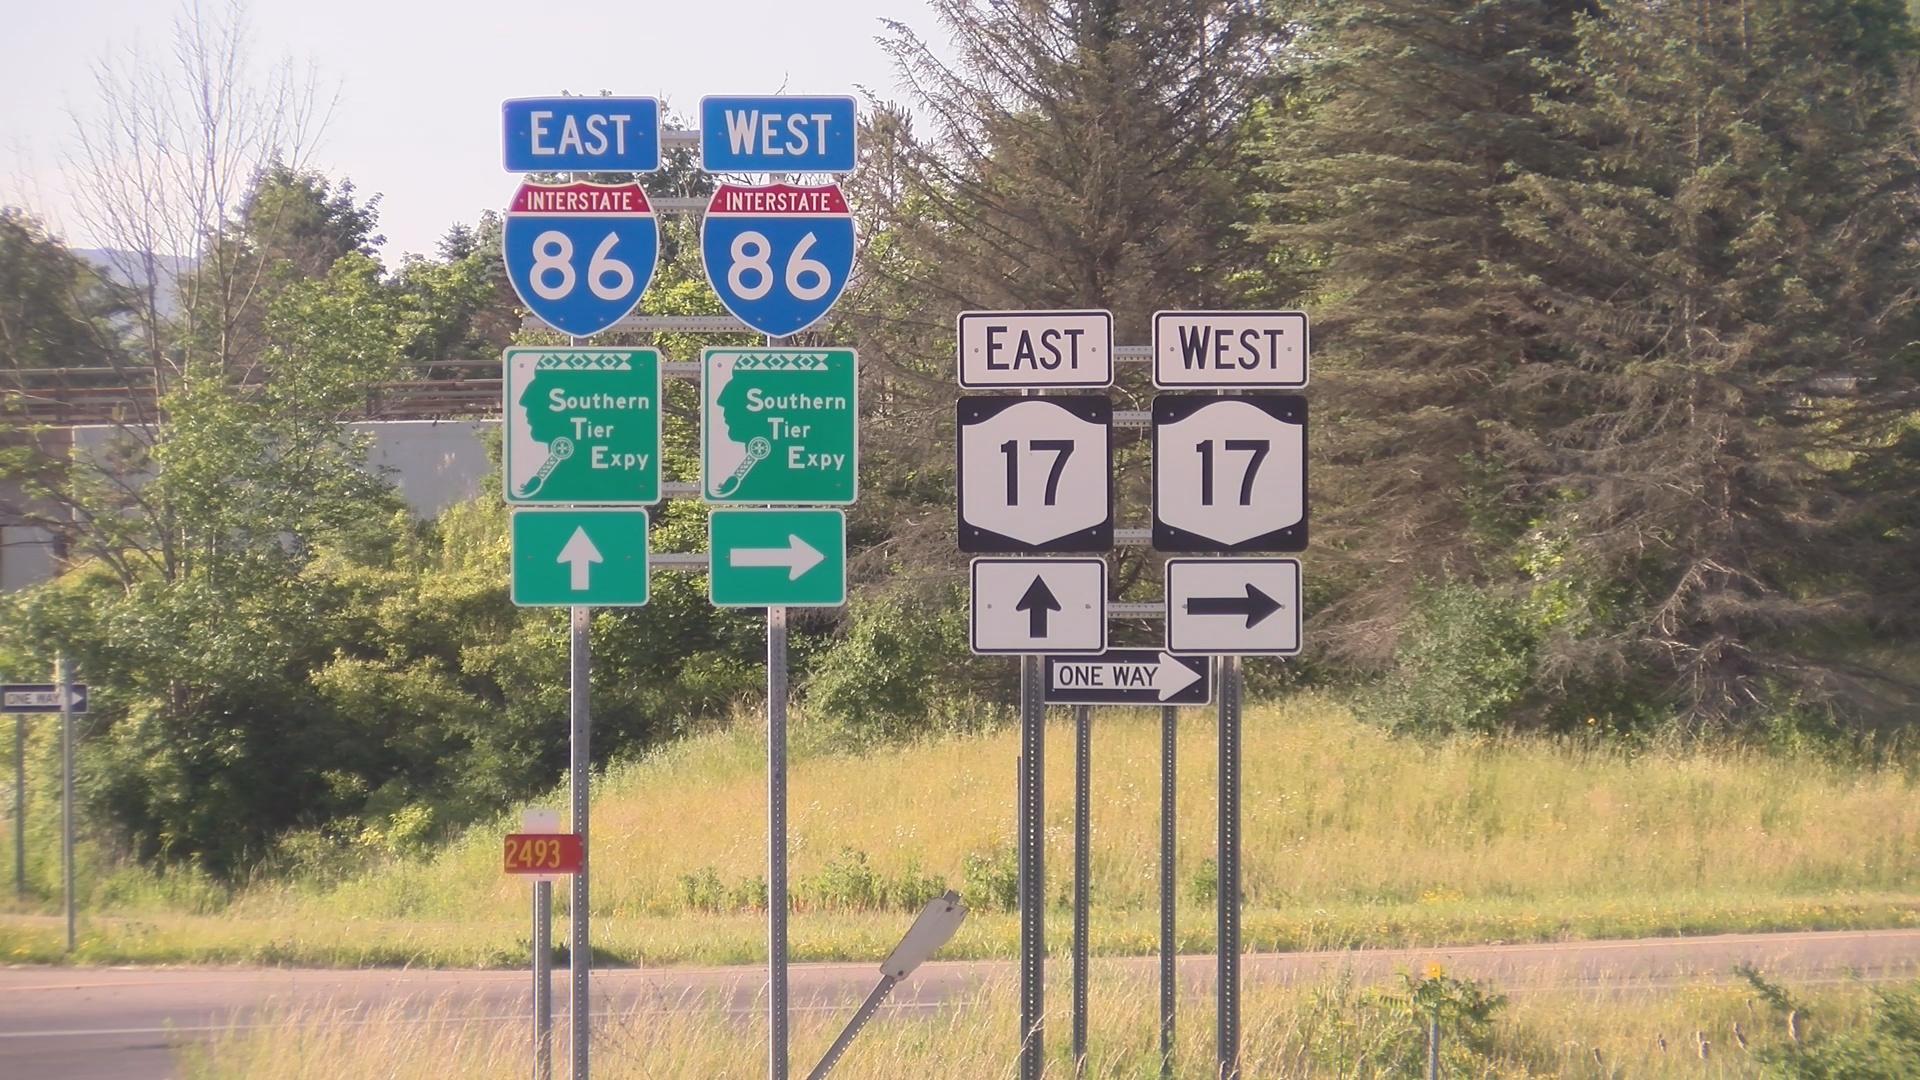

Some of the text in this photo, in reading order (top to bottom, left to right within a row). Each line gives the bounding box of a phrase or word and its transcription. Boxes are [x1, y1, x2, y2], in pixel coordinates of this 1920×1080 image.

[531, 111, 630, 155] EAST
[725, 110, 832, 155] WEST
[527, 191, 632, 211] INTERSTATE
[726, 191, 831, 212] INTERSTATE
[529, 230, 634, 300] 86
[727, 230, 831, 300] 86
[986, 326, 1084, 370] EAST
[1178, 325, 1284, 370] WEST
[549, 388, 650, 412] Southern
[746, 388, 846, 412] Southern
[570, 417, 614, 440] Tier
[767, 417, 811, 440] Tier
[591, 446, 649, 471] Expy
[788, 446, 846, 471] Expy
[1000, 440, 1075, 506] 17
[1196, 440, 1270, 506] 17
[1059, 666, 1158, 687] ONE WAY
[7, 693, 60, 705] ONE WAY
[505, 839, 561, 868] 2493
